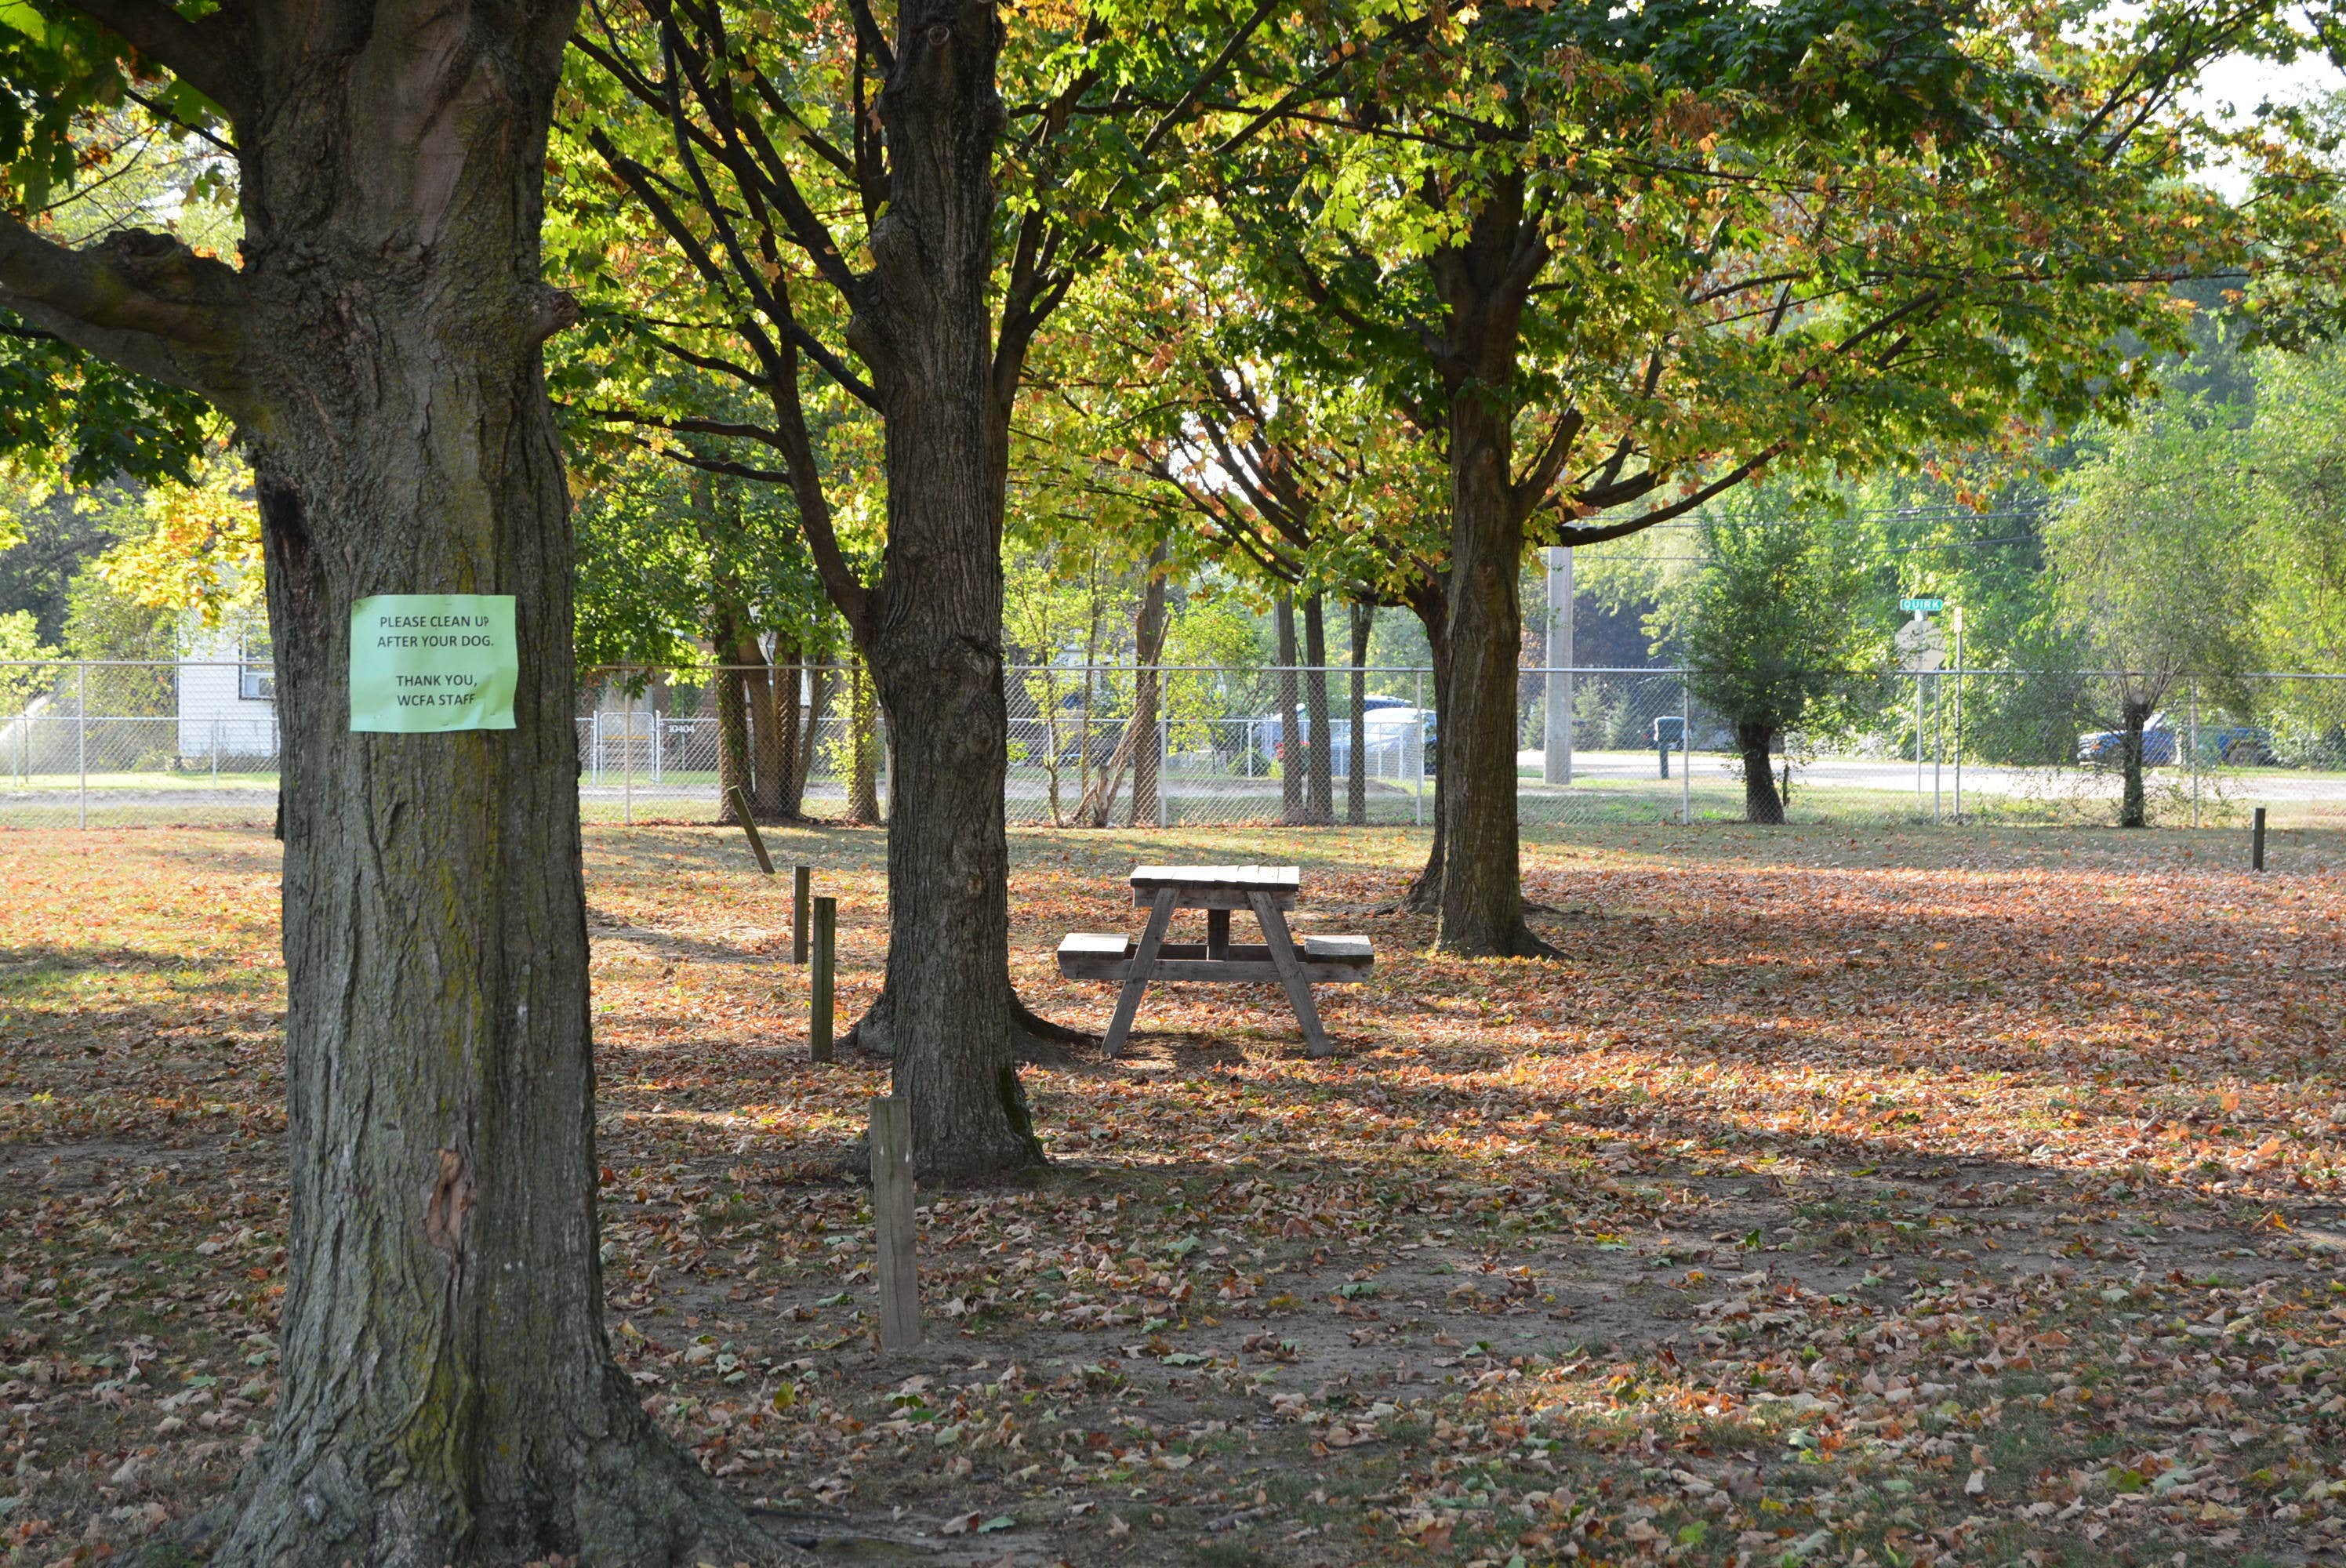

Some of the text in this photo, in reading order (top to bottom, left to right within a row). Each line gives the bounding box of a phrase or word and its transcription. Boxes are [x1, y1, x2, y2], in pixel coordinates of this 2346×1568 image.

[1904, 600, 1940, 609] QUIRK
[380, 615, 489, 627] PLEASE CLEAN UP
[377, 635, 494, 648] AFTER YOUR DOG.
[396, 674, 478, 688] THANK YOU,
[397, 694, 475, 706] WCFA STAFF
